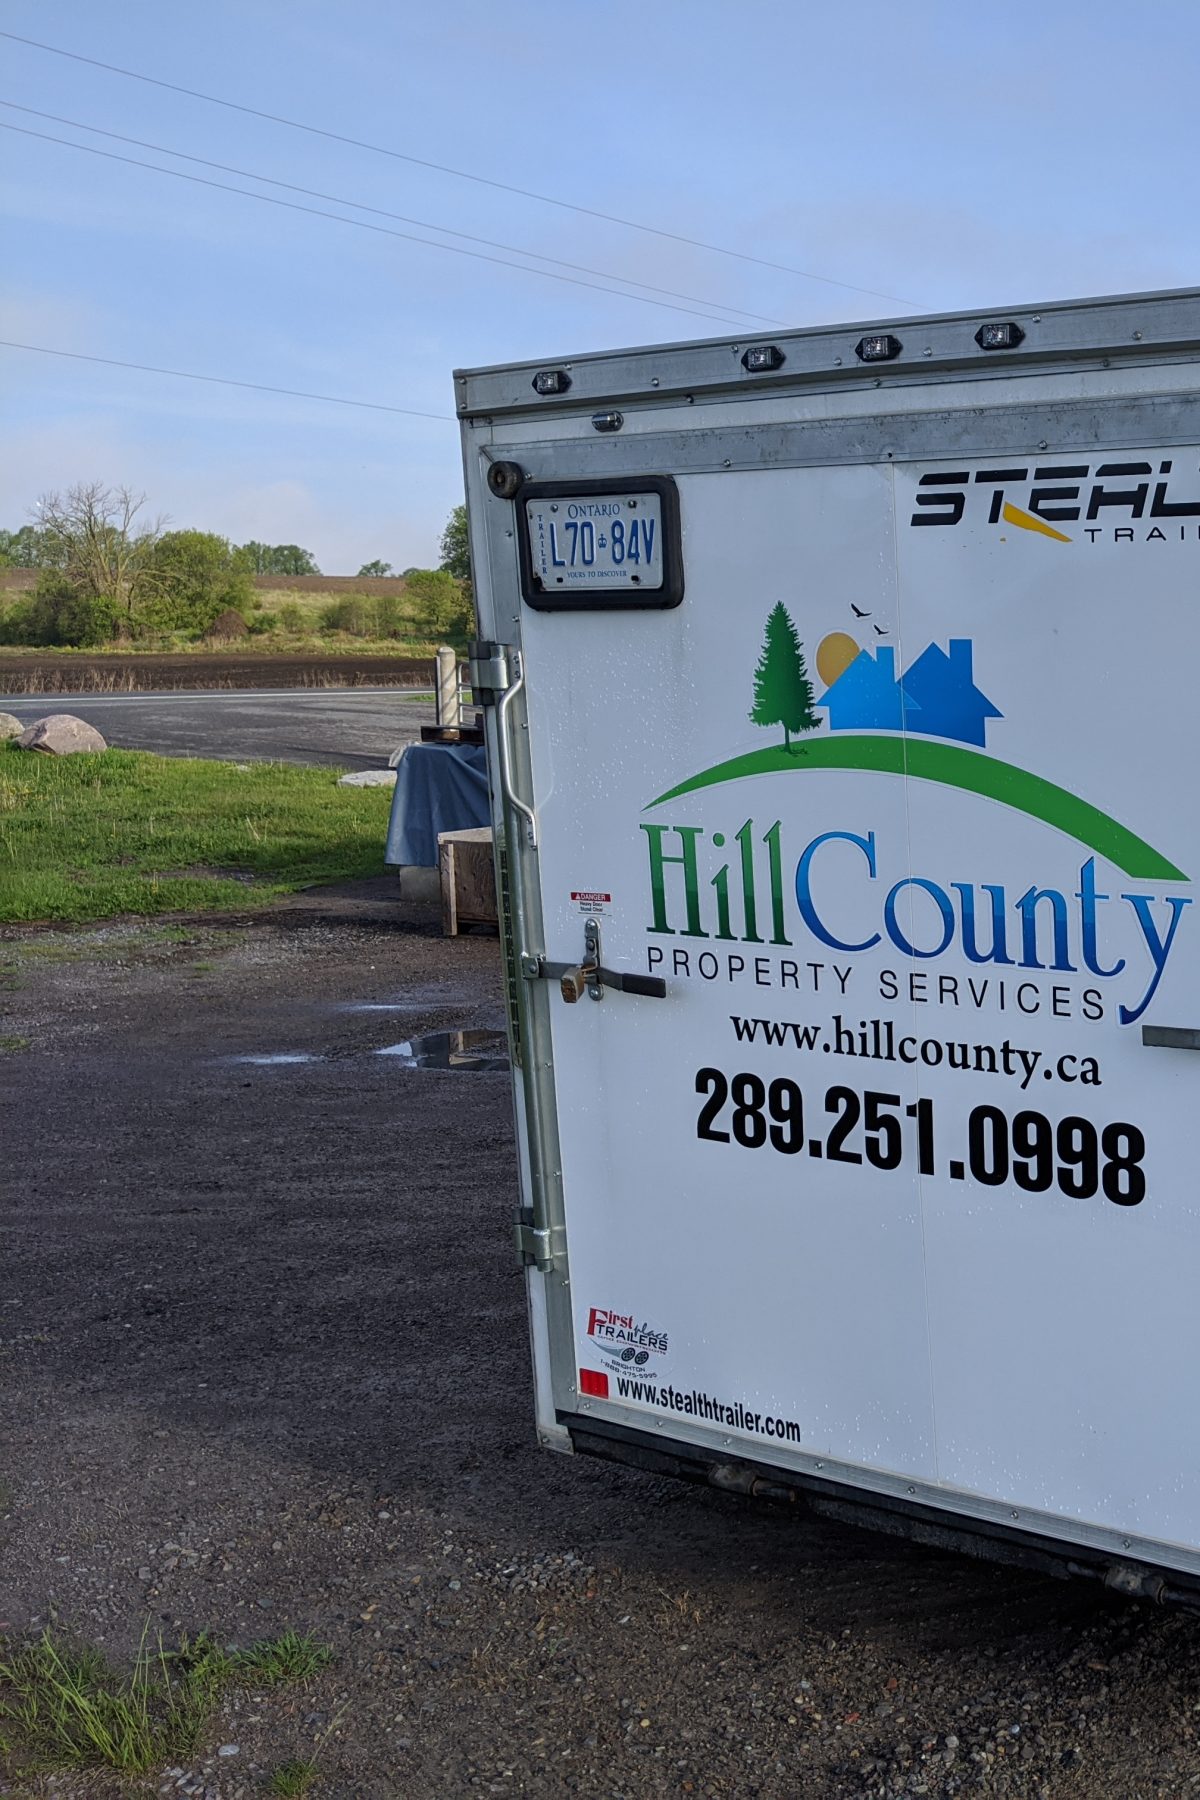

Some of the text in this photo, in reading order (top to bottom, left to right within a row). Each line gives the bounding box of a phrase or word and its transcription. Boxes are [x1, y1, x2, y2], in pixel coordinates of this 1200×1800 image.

[537, 514, 548, 574] TRAILER
[550, 518, 655, 566] L70 84V
[597, 570, 627, 578] DISCOVER
[648, 946, 1104, 1020] PROPERTY SERVICES
[729, 1016, 1102, 1090] www.hillcounty.ca
[695, 1067, 1146, 1206] 289.251.0998
[587, 1307, 669, 1341] First place
[596, 1323, 668, 1351] TRAILERS
[611, 1359, 646, 1372] BRIGHTON
[617, 1377, 801, 1442] www.stealthtrailer.com
